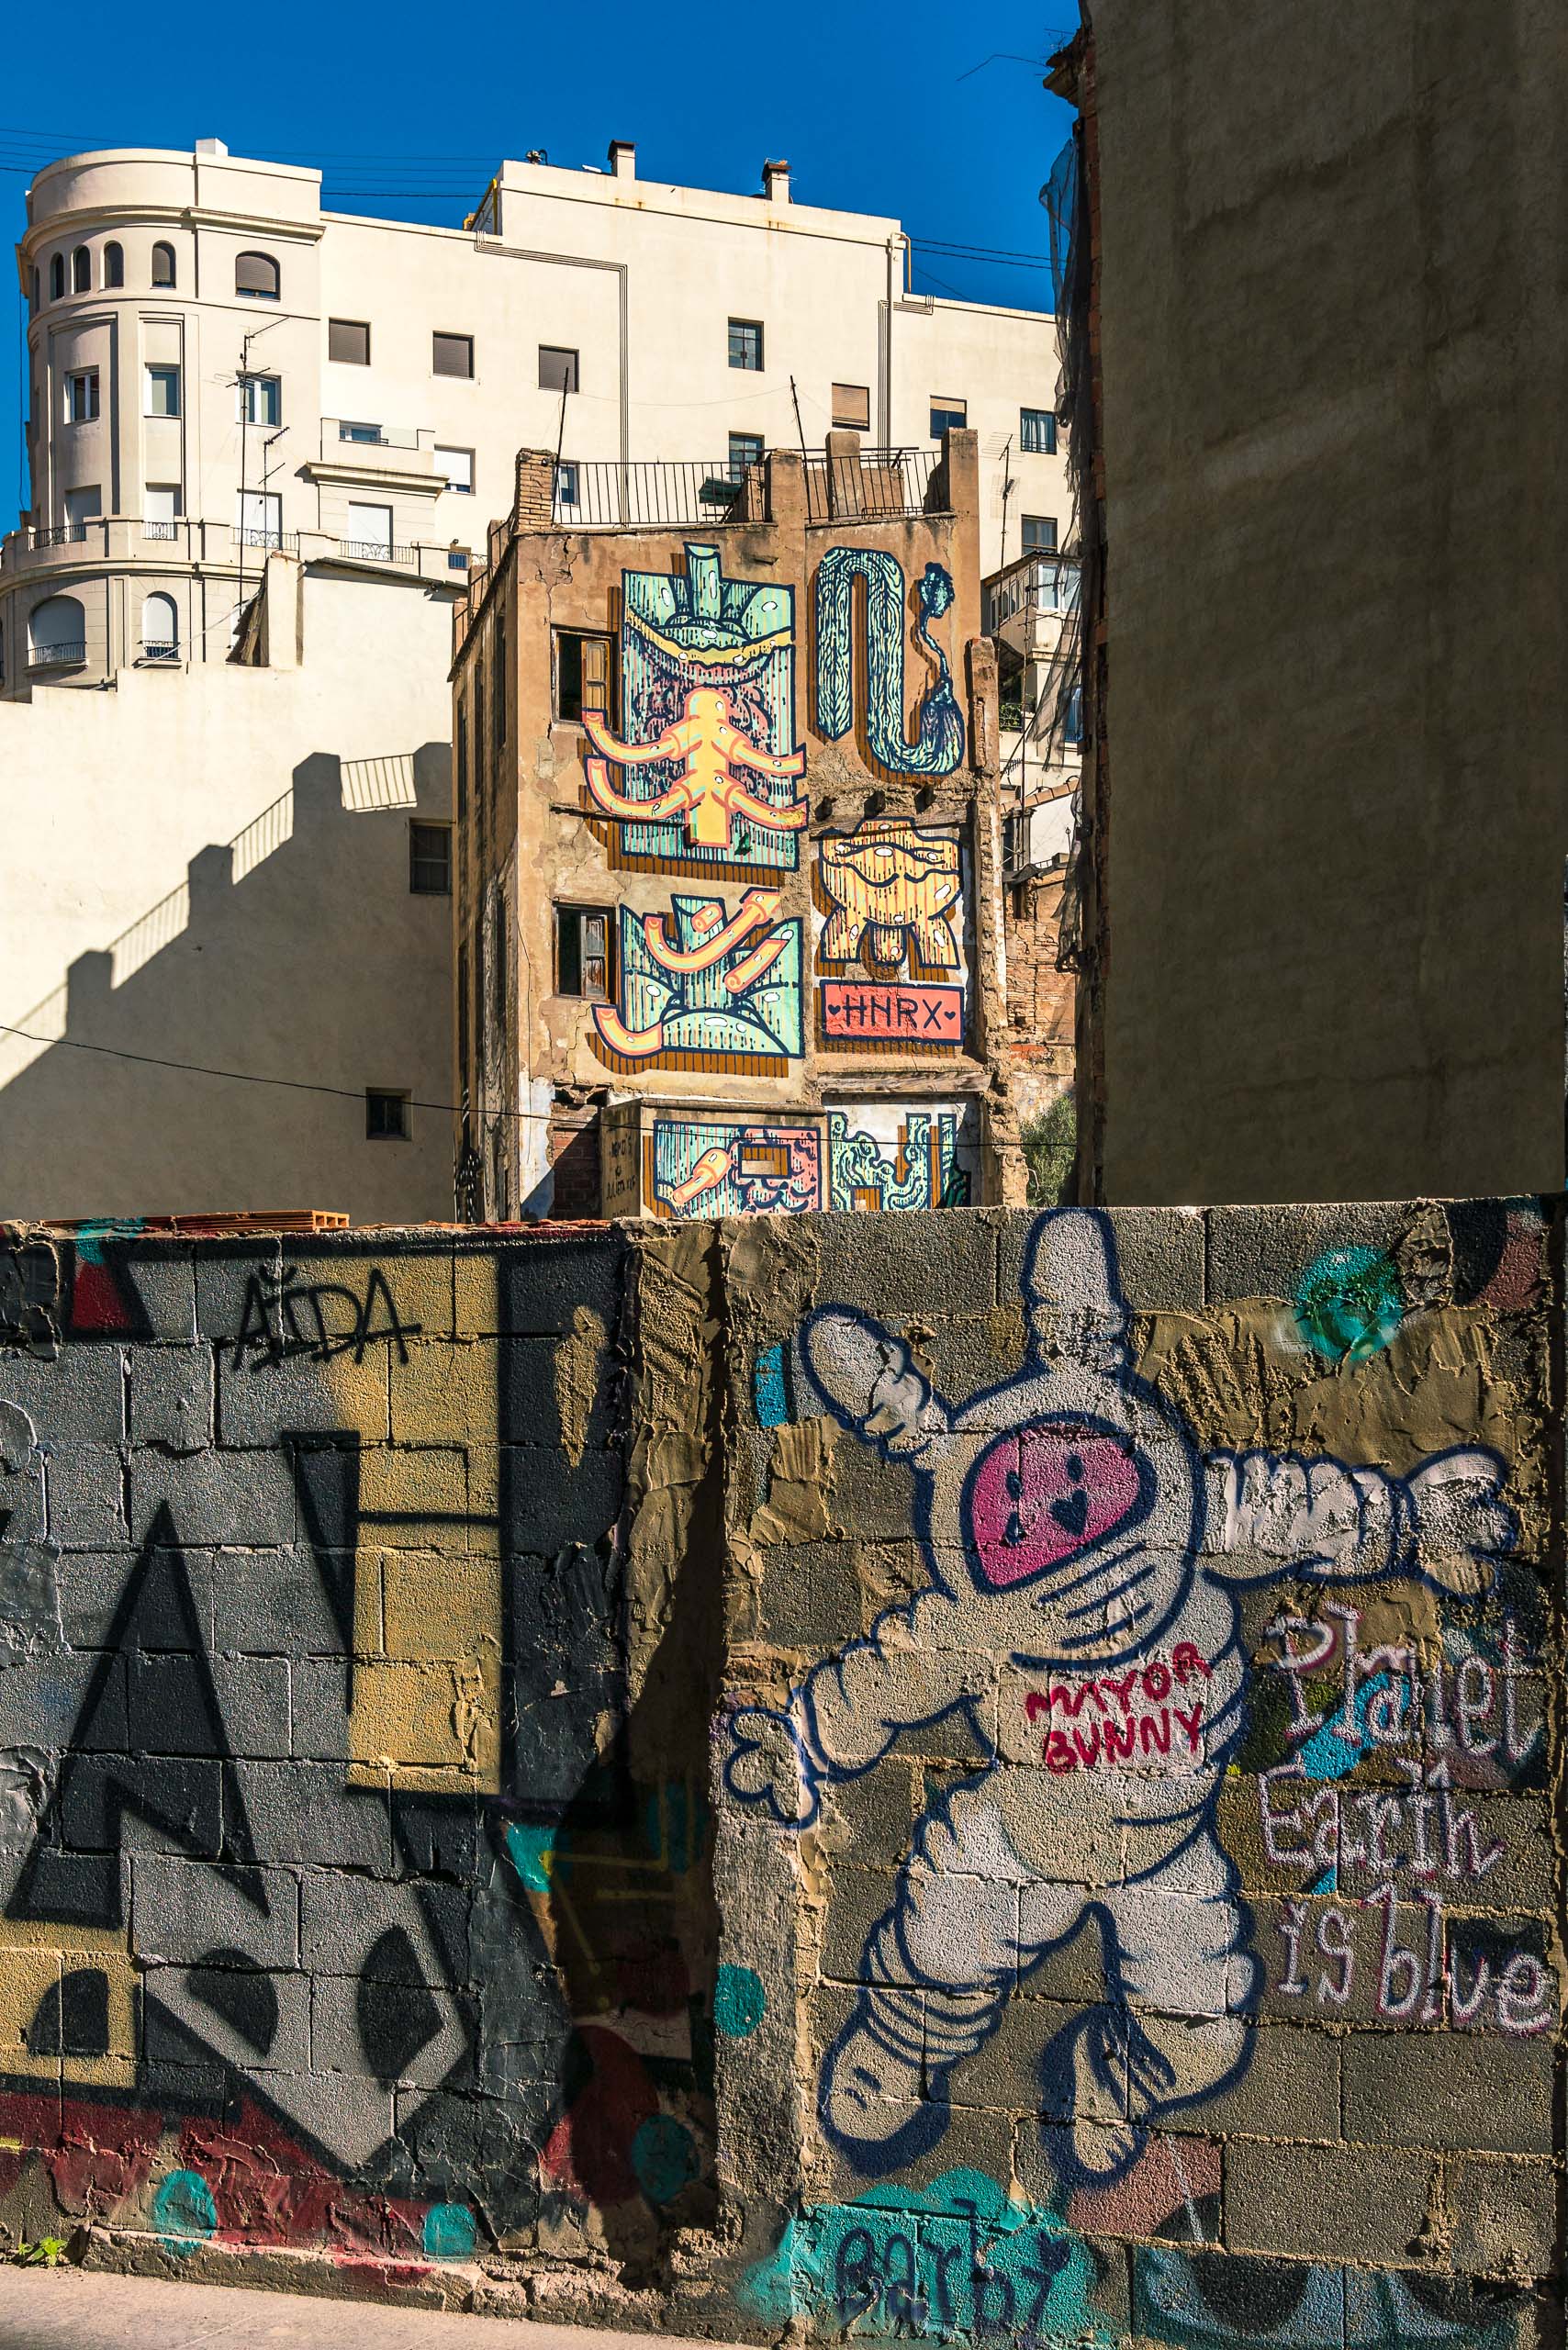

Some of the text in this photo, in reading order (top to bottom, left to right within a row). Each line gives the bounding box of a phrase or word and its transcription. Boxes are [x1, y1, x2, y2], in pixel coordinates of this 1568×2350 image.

[843, 994, 943, 1030] HNRX
[1025, 1641, 1213, 1722] MAYOR
[1258, 1600, 1546, 1762] Planet
[1044, 1702, 1204, 1777] BUNNY
[1259, 1740, 1507, 1881] Earth
[1278, 1882, 1553, 2037] is blue
